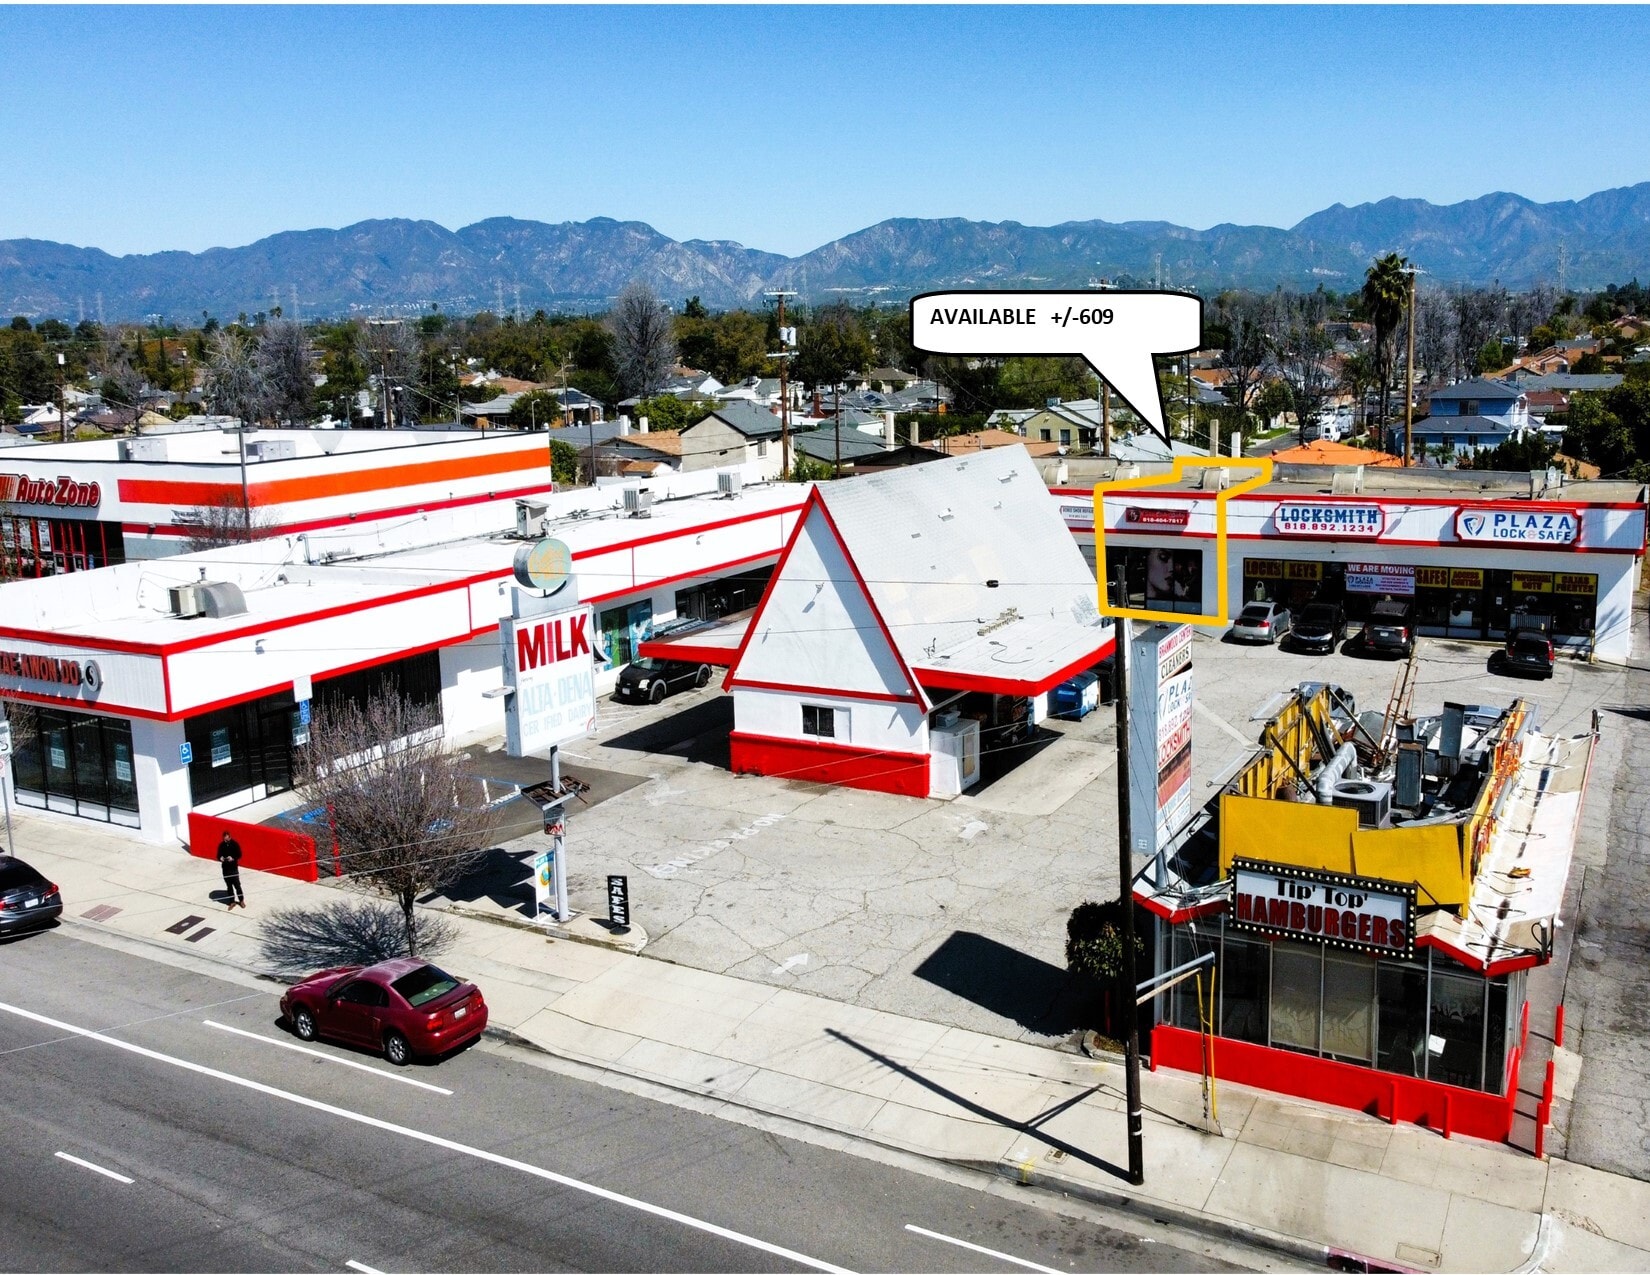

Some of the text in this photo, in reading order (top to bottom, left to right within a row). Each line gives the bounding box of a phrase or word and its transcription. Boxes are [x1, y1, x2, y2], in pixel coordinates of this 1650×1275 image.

[17, 476, 101, 507] AutoZone
[1281, 508, 1377, 524] LOCKSMITH
[1494, 514, 1571, 529] PLAZA
[1284, 522, 1373, 533] 818.892.1234
[1493, 528, 1526, 539] LOCK
[1538, 530, 1571, 541] SAFE
[1246, 560, 1317, 579] LOCKS KEYS
[1347, 564, 1415, 575] WE ARE MOVING
[1416, 568, 1447, 585] SAFES
[517, 614, 590, 672] MILK
[21, 654, 58, 682] KWON
[61, 659, 80, 686] DO
[611, 878, 626, 925] SAFES
[1236, 892, 1406, 949] HAMBURGERS
